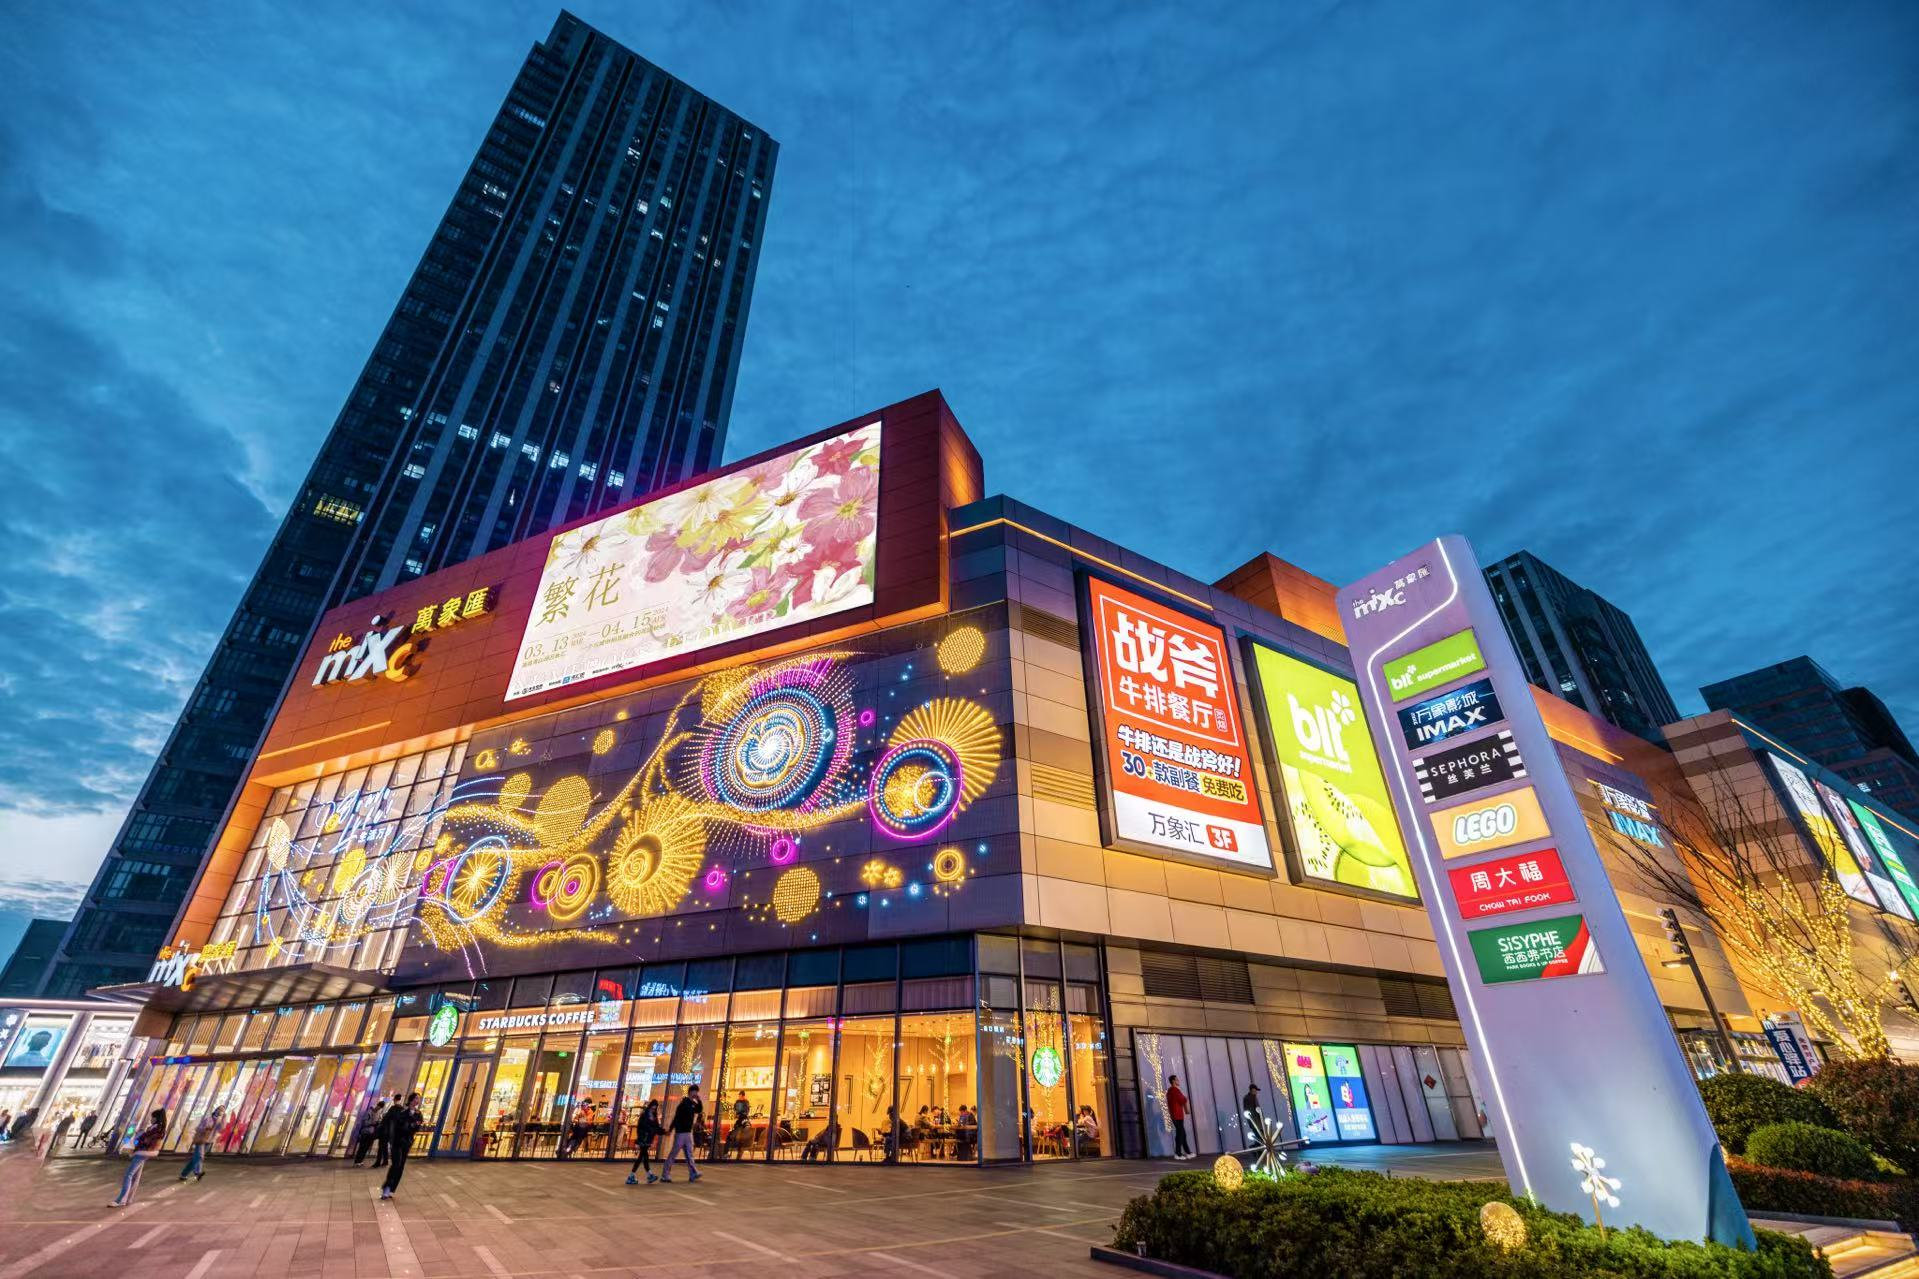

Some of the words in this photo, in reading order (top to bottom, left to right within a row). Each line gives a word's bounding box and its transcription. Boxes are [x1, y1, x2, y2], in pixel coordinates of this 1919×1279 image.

[535, 563, 626, 627] 繁花
[329, 633, 352, 652] the
[1111, 611, 1218, 699] 战斧
[1417, 652, 1477, 682] supermarket
[1119, 675, 1213, 728] 牛排餐厅
[1416, 690, 1480, 723] 万象影城
[1416, 706, 1487, 741] IMAX
[1430, 748, 1502, 777] SEPHORA
[1447, 763, 1493, 785] 丝芙兰
[1148, 812, 1204, 845] 万象汇
[1212, 829, 1232, 849] 3F
[1455, 805, 1516, 845] LEGO
[1610, 811, 1665, 848] IMAX
[1470, 861, 1544, 893] 周大福
[1480, 901, 1505, 912] CHOW
[1506, 898, 1522, 906] TAI
[1524, 893, 1551, 903] FOOK
[1502, 945, 1566, 964] 西西弗书店
[479, 1013, 546, 1030] STARBUCKS
[549, 1010, 595, 1025] COFFEE
